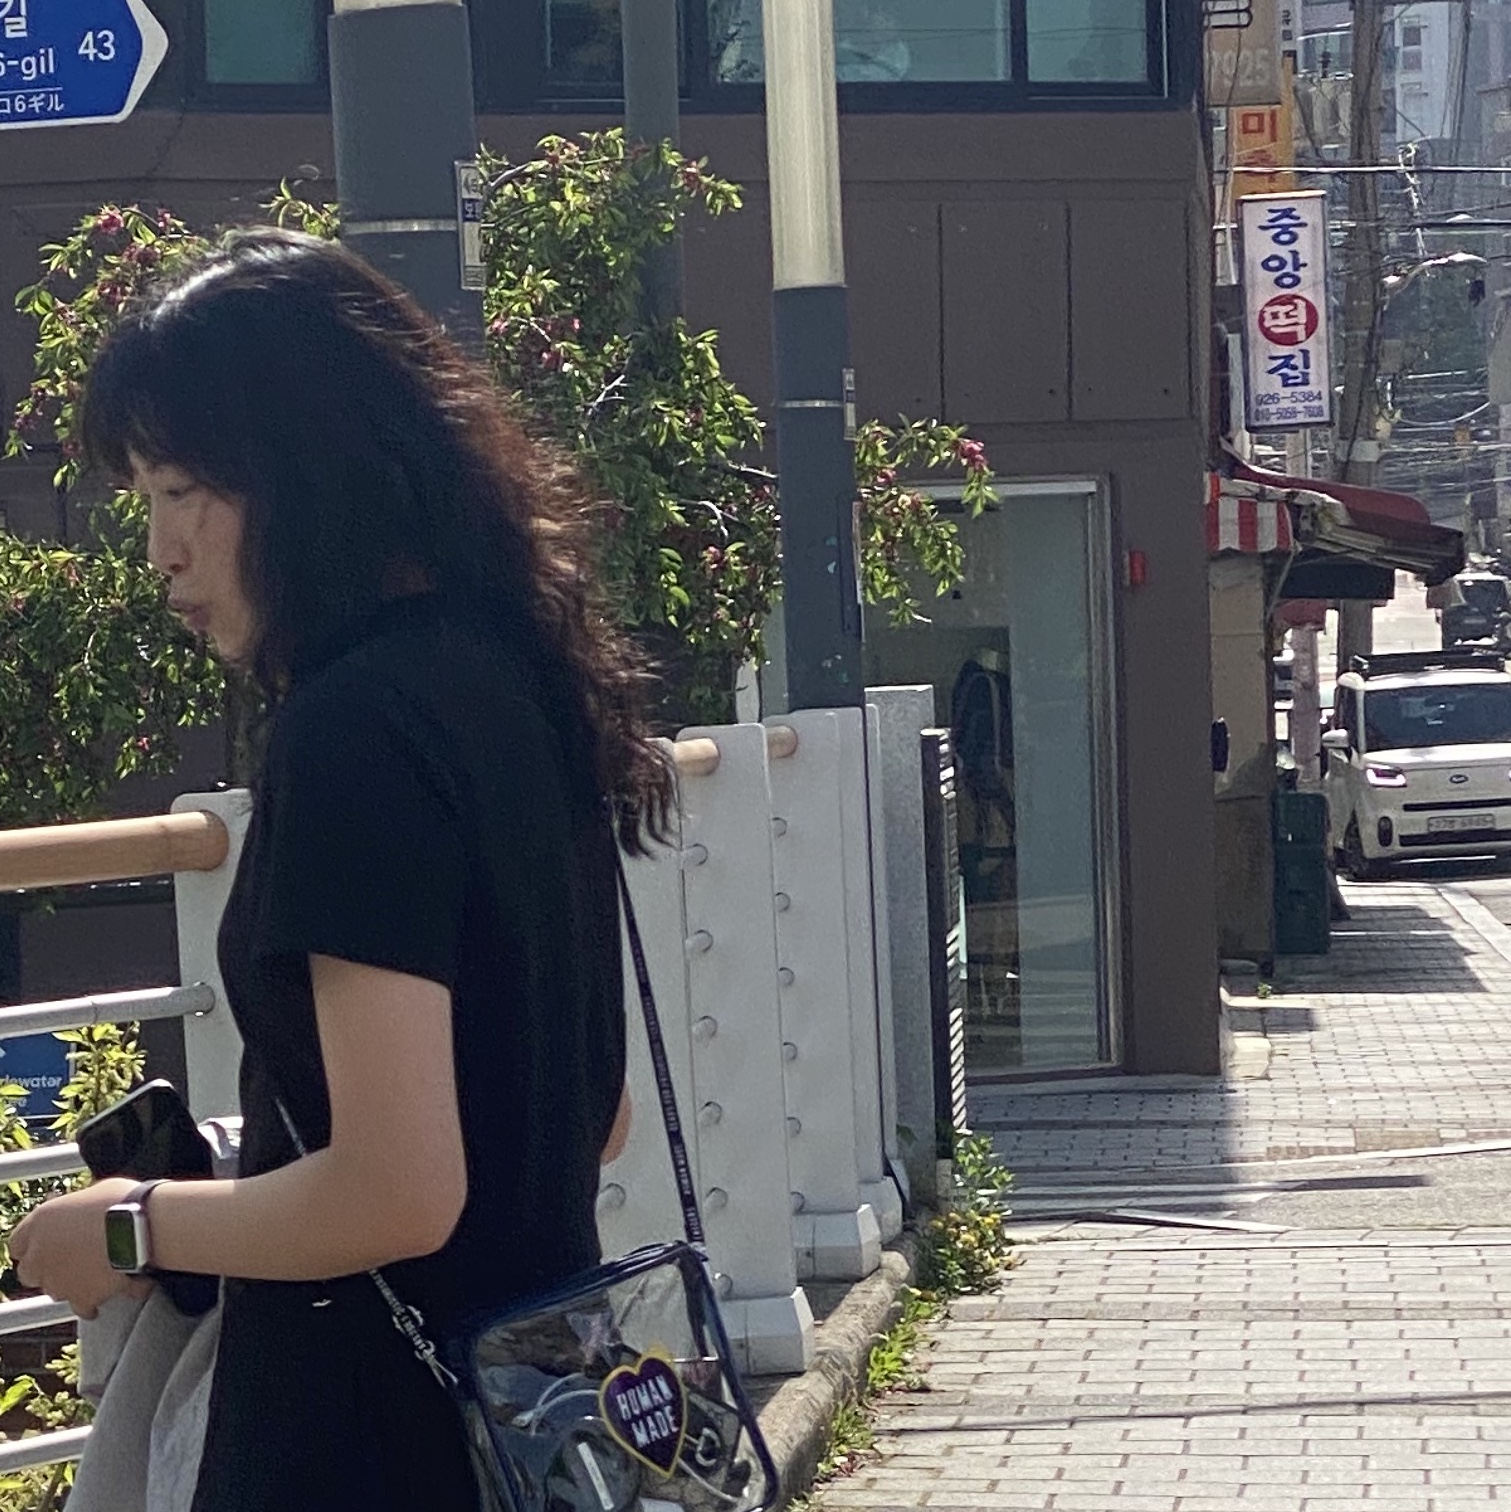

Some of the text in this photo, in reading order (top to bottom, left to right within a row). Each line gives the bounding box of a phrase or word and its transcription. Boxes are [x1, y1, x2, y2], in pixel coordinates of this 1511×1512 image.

[78, 30, 116, 61] 43
[1257, 207, 1319, 388] 중앙떡집
[616, 1375, 673, 1420] HUMAN
[631, 1405, 679, 1447] MADE
